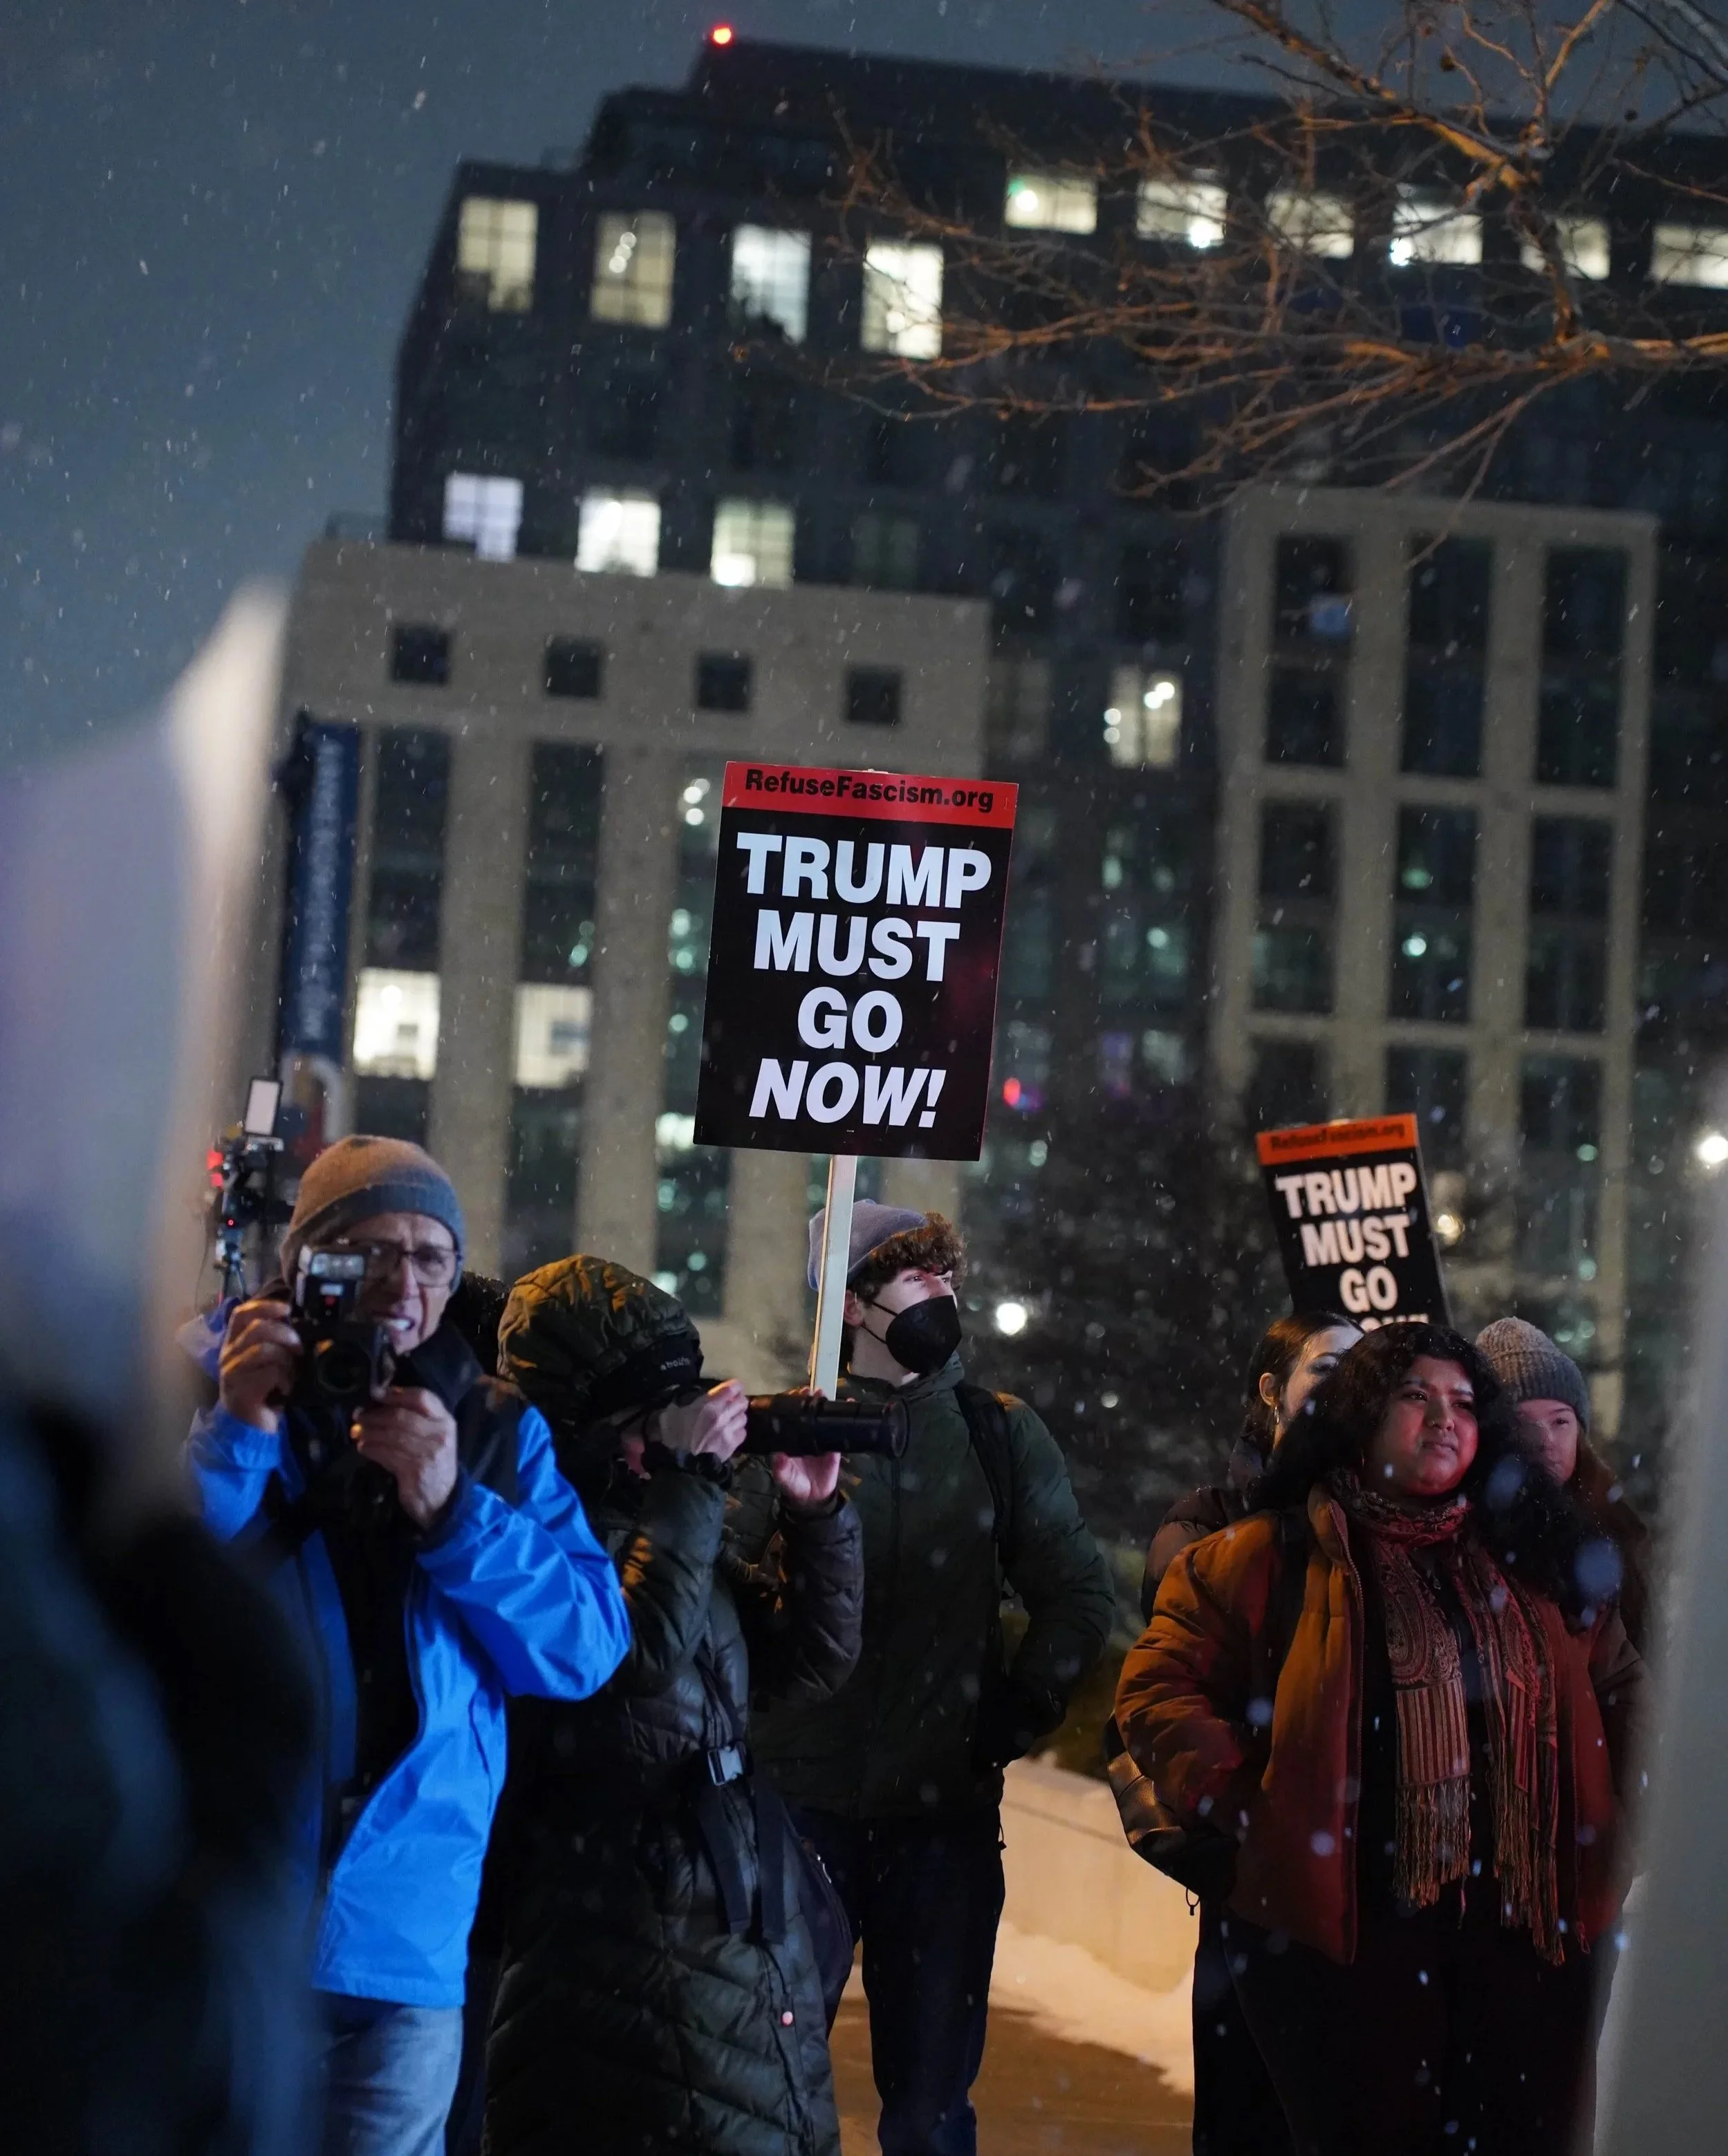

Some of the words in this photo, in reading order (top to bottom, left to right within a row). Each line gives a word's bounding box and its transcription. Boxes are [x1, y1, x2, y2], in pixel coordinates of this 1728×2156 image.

[745, 769, 994, 813] RefuseFascism.org
[736, 832, 992, 909] TRUMP
[754, 909, 960, 982] MUST
[797, 986, 903, 1053] GO
[748, 1058, 947, 1128] NOW!
[1274, 1162, 1417, 1218] TRUMP
[1300, 1214, 1410, 1267] MUST
[1339, 1265, 1398, 1313] GO
